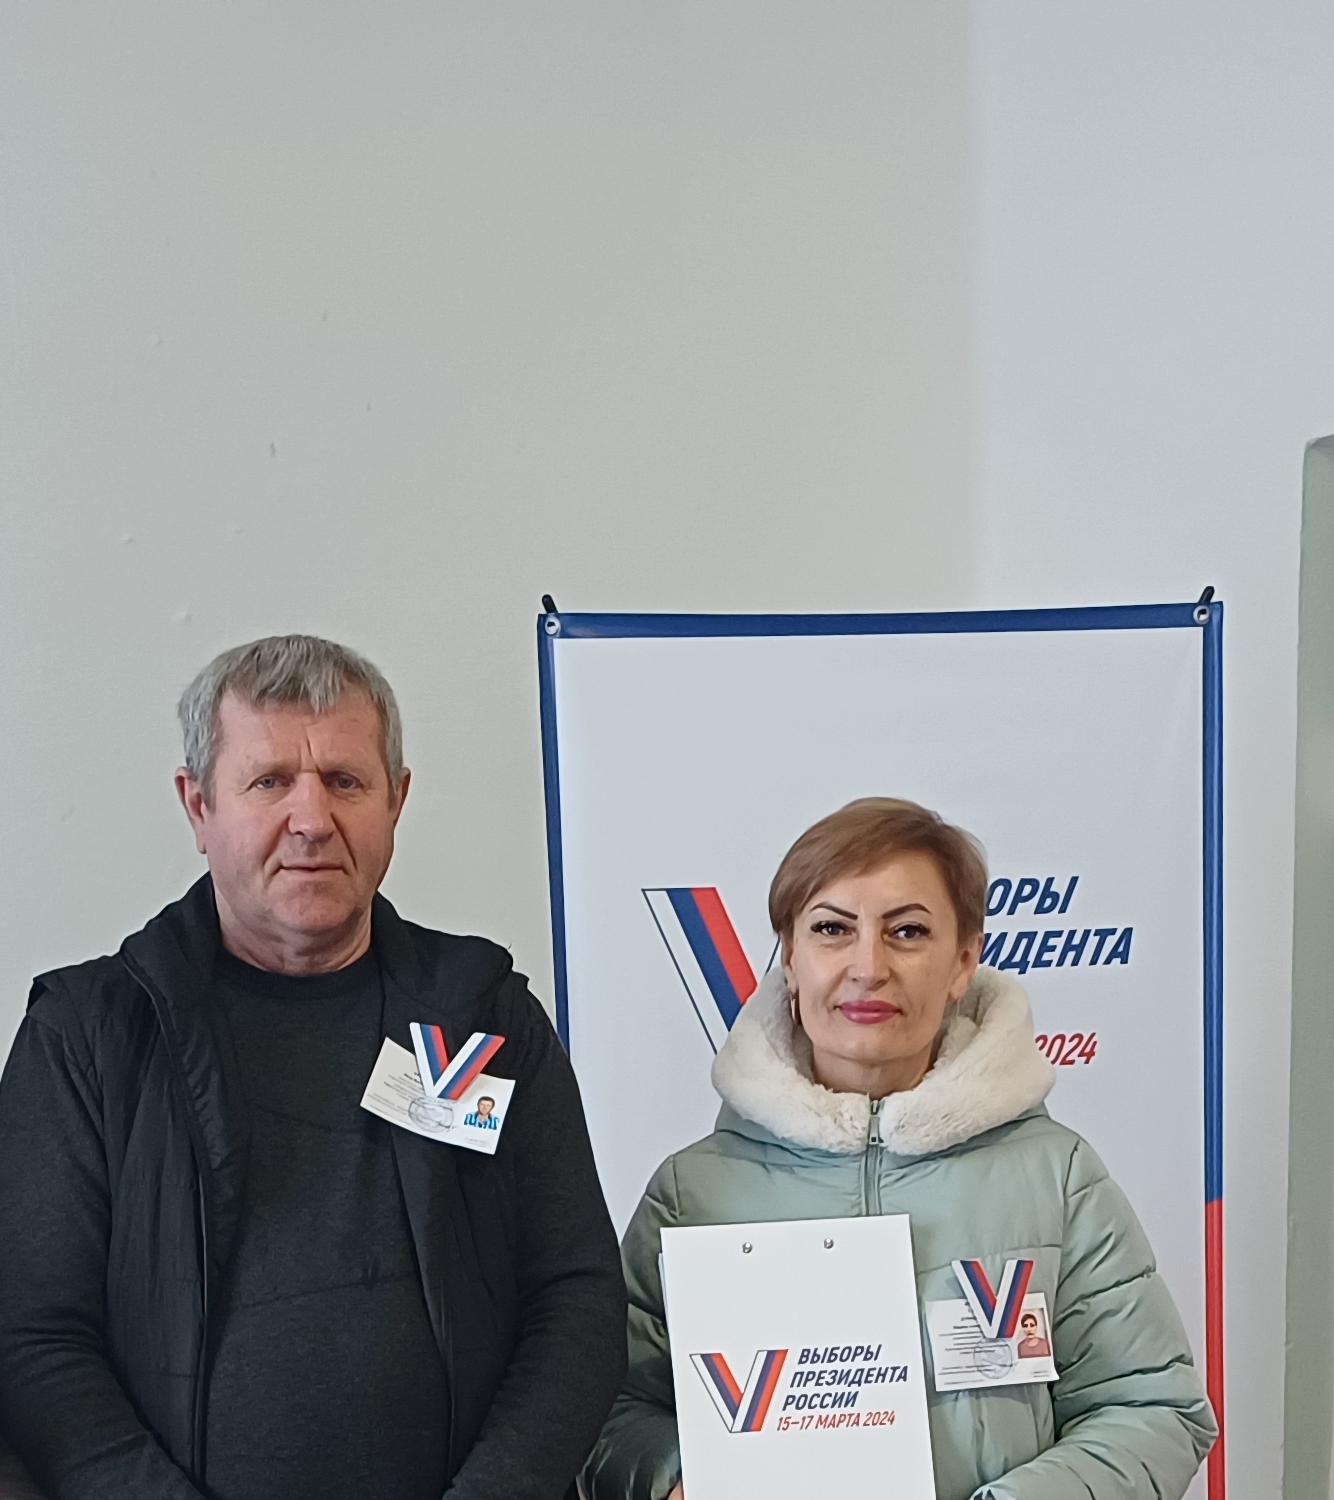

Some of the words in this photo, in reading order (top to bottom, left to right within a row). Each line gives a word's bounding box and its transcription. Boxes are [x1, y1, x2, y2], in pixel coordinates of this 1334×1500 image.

[984, 876, 1079, 917] ОРЫ
[978, 926, 1134, 975] ИДЕНТА
[797, 1344, 882, 1366] ВЫБОРЫ
[789, 1365, 909, 1389] ПРЕЗИДЕНТА
[782, 1390, 860, 1412] РОССИИ
[815, 1412, 861, 1430] МАРТА
[862, 1410, 896, 1428] 2024
